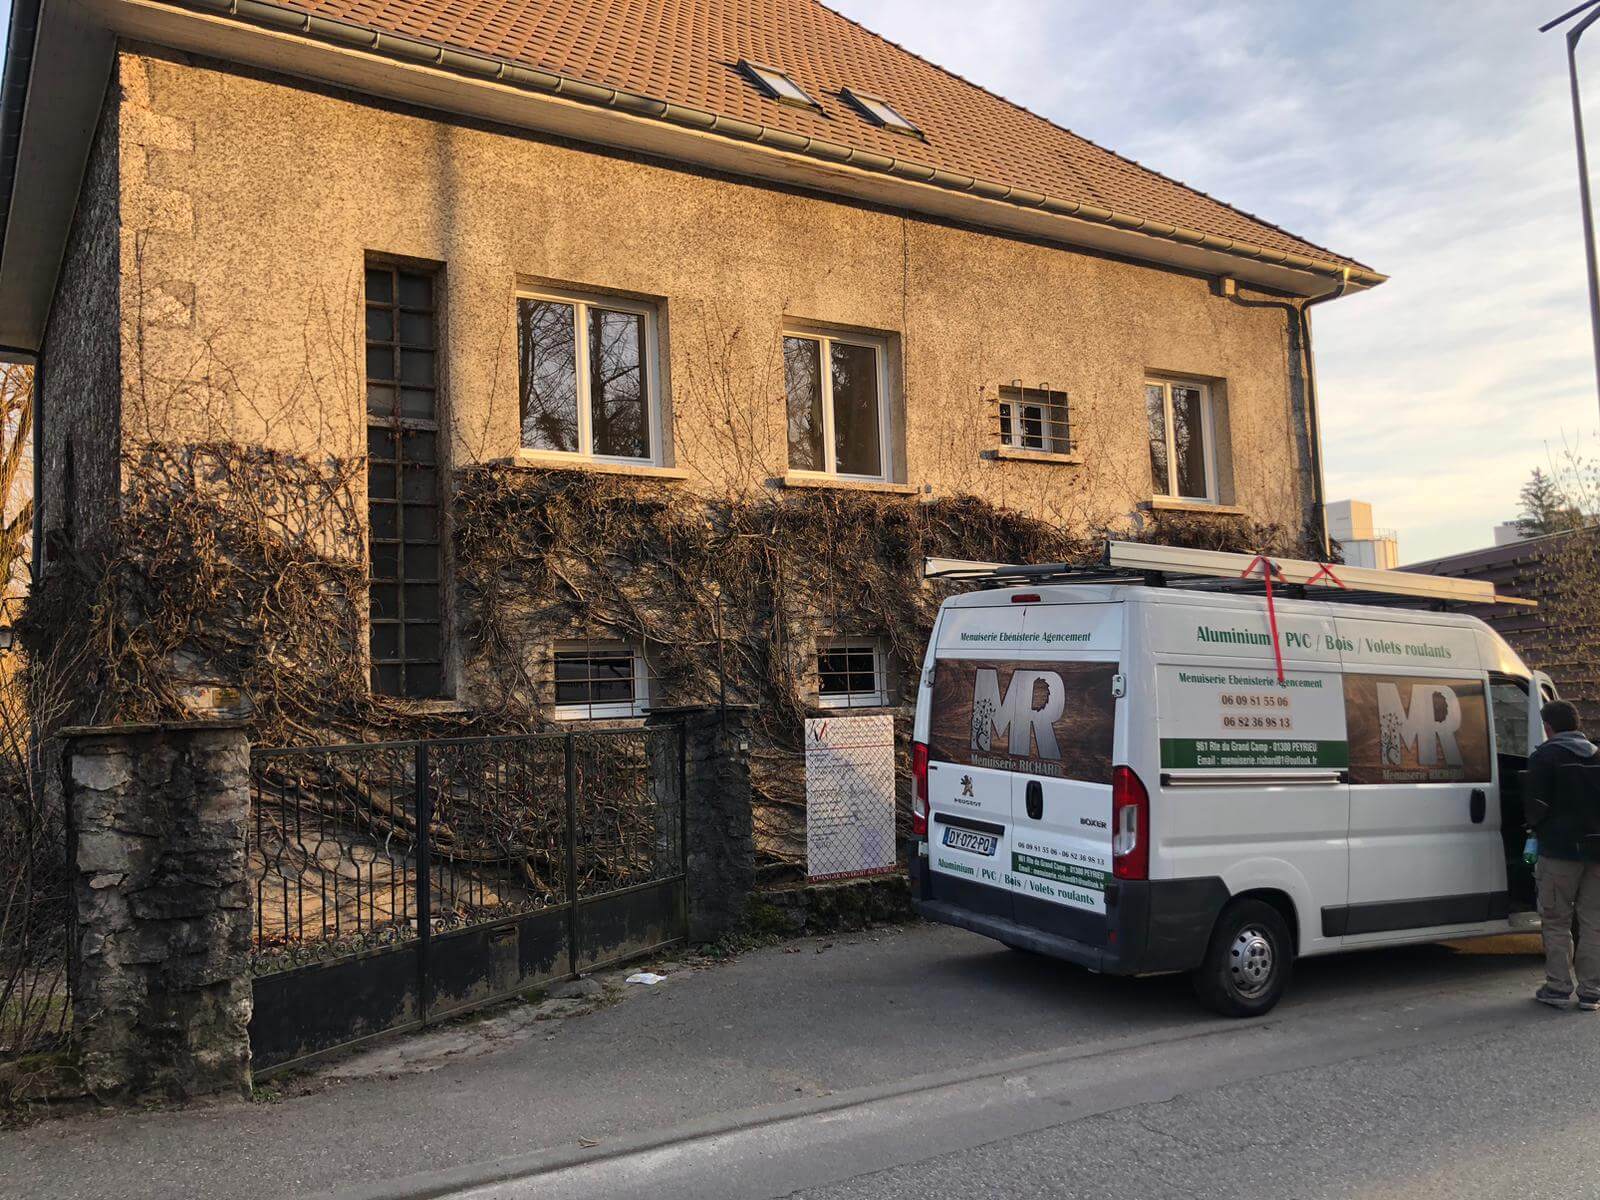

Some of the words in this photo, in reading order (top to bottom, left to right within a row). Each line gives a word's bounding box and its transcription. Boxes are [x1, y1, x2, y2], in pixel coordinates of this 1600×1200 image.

[960, 632, 998, 642] Menuiserie
[1041, 631, 1092, 643] Agencement
[1197, 625, 1272, 646] Aluminium
[1286, 632, 1312, 648] PVC
[1325, 635, 1354, 651] Bois
[1365, 638, 1402, 655] Volets
[1405, 643, 1452, 660] roulants
[1178, 672, 1227, 685] Menuiserie
[1221, 695, 1234, 706] 06
[1236, 695, 1248, 706] 09
[1263, 697, 1275, 707] 55
[1277, 697, 1289, 708] 06
[971, 668, 1066, 761] MR
[1223, 716, 1236, 728] 06
[1252, 717, 1264, 728] 36
[1279, 718, 1290, 728] 13
[1376, 682, 1464, 766] MR
[1080, 817, 1107, 829] BOXER
[938, 858, 974, 875] Aluminium
[982, 869, 997, 881] PVC
[1005, 874, 1021, 888] Bois
[1029, 880, 1055, 897] Volets
[1057, 889, 1095, 906] roulants
